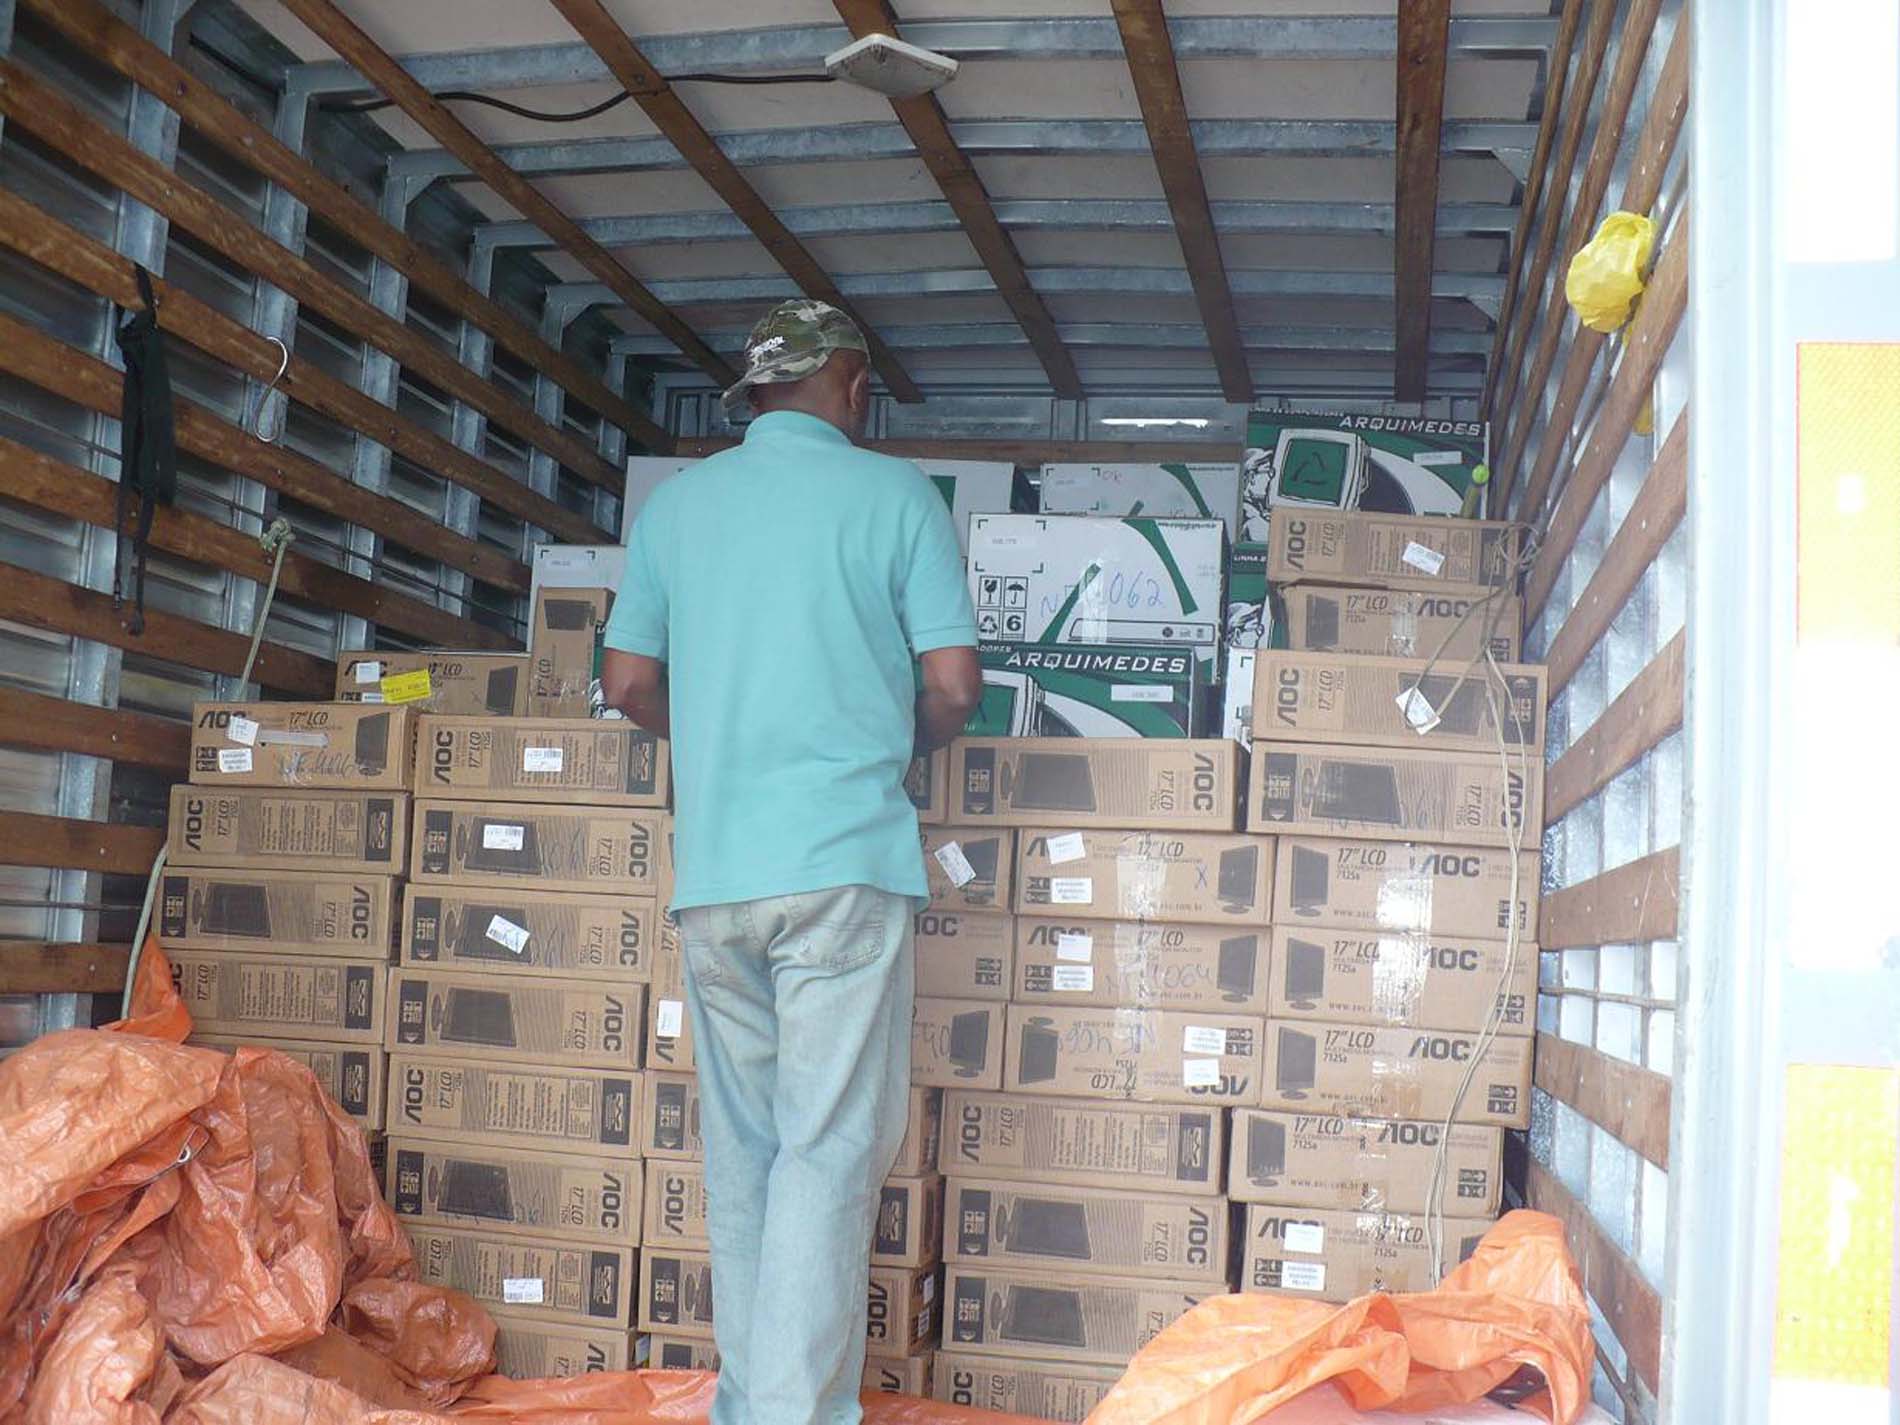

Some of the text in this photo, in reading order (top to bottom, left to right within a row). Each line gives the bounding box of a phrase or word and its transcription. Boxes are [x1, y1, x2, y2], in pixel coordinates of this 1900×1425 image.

[1339, 415, 1482, 437] ARQUIMEDES
[1322, 523, 1335, 541] LCD
[1287, 520, 1307, 572] AOC
[1347, 595, 1389, 609] 17" LCD
[1417, 600, 1471, 618] AOC
[1006, 615, 1021, 631] 6
[443, 663, 462, 676] LCD
[1005, 652, 1187, 673] ARQUIMEDES
[1277, 667, 1300, 727] AOC
[1318, 670, 1335, 711] 17" LCD
[199, 711, 247, 729] AO
[307, 712, 329, 725] LCD
[468, 731, 482, 749] LCD
[431, 730, 455, 785] AOC
[1192, 752, 1214, 811] AOC
[1160, 786, 1173, 810] LCD
[1502, 770, 1524, 829] AOC
[218, 801, 230, 818] LCD
[1467, 804, 1480, 826] LCD
[184, 799, 204, 852] AOC
[628, 822, 651, 879] AOC
[1160, 841, 1185, 857] LCD
[1338, 848, 1387, 866] 17" LCD
[598, 855, 611, 876] LCD
[1419, 853, 1481, 877] AOC
[351, 886, 370, 939] AOC
[322, 918, 334, 937] LCD
[620, 910, 641, 966] AOC
[1160, 930, 1185, 946] LCD
[590, 943, 603, 964] LCD
[1333, 941, 1355, 956] 17"
[197, 964, 209, 982] LCD
[603, 995, 625, 1052] AOC
[574, 1026, 588, 1049] LCD
[1325, 1030, 1374, 1048] 17" LCD
[1408, 1036, 1471, 1061] AOC
[440, 1071, 454, 1090] LCD
[1091, 1074, 1116, 1090] LCD
[401, 1070, 423, 1124] AOC
[1001, 1108, 1014, 1127] LCD
[1294, 1117, 1344, 1135] 17" LCD
[961, 1105, 982, 1163] AOC
[1377, 1122, 1440, 1147] AOC
[602, 1172, 622, 1229] AOC
[665, 1178, 685, 1235] AOC
[571, 1202, 584, 1225] LCD
[1187, 1207, 1208, 1265] AOC
[429, 1239, 441, 1260] LCD
[1155, 1240, 1169, 1262] LCD
[868, 1281, 888, 1339] AOC
[953, 1372, 973, 1406] OC
[991, 1375, 1004, 1396] LCD
